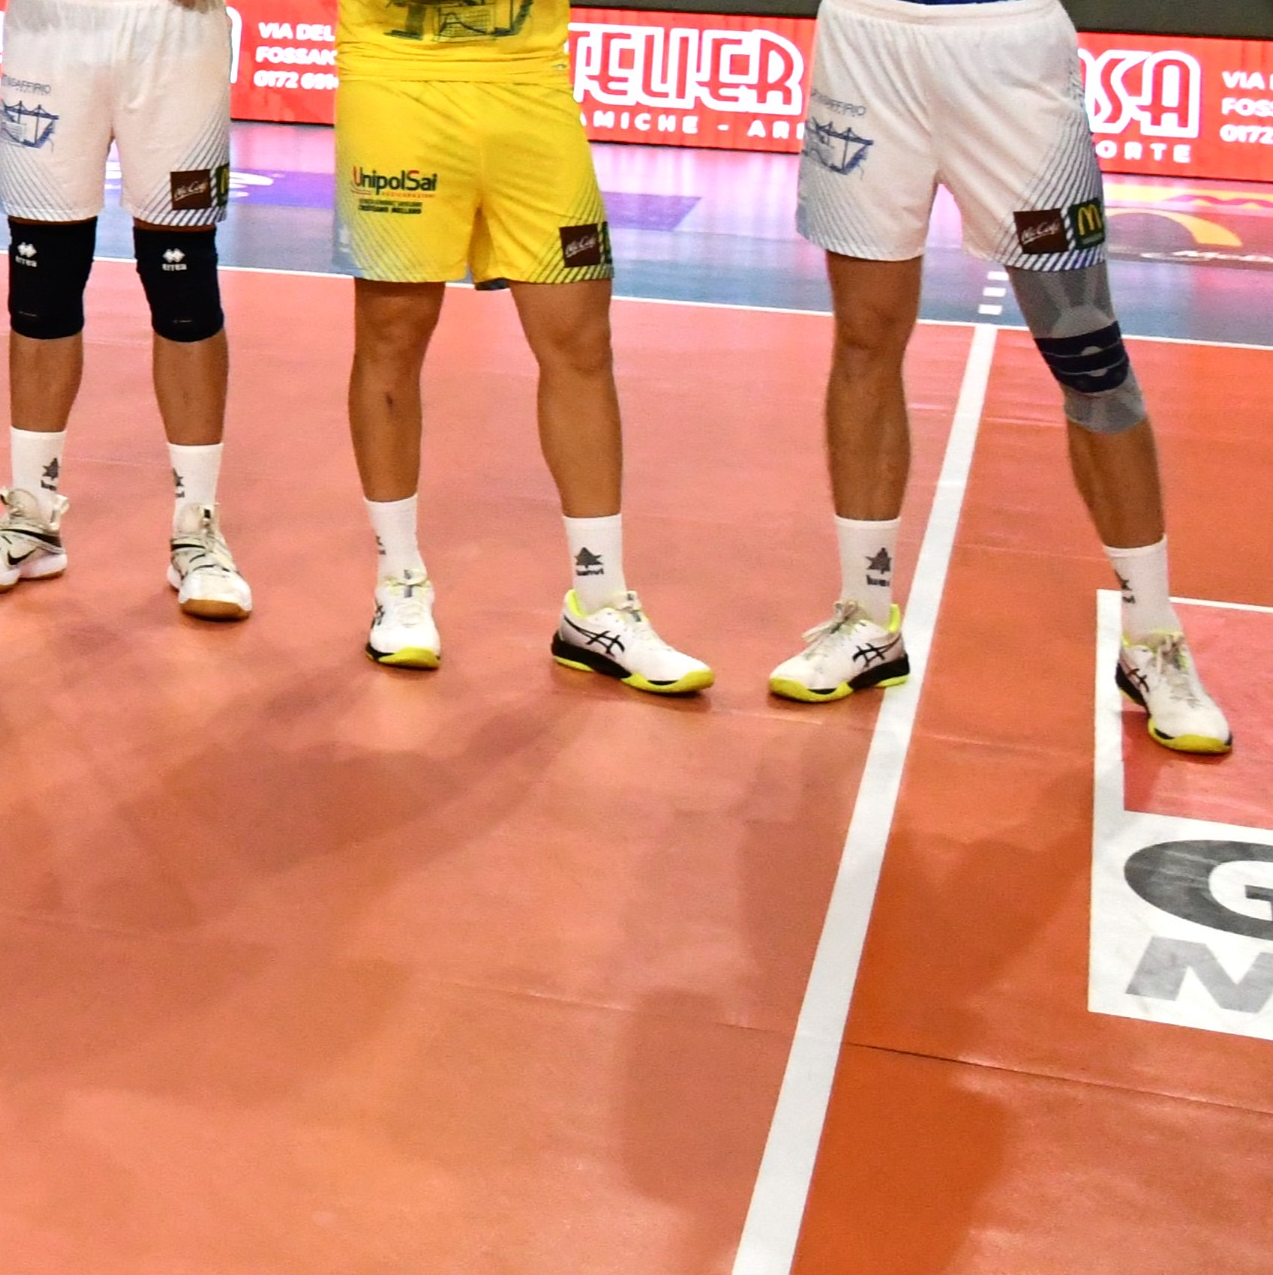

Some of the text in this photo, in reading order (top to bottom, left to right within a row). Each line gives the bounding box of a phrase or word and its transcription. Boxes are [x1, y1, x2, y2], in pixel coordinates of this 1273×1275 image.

[258, 22, 293, 39] VIA
[254, 70, 299, 88] 0172
[1222, 71, 1264, 89] VIA
[353, 166, 436, 195] UnipolSai
